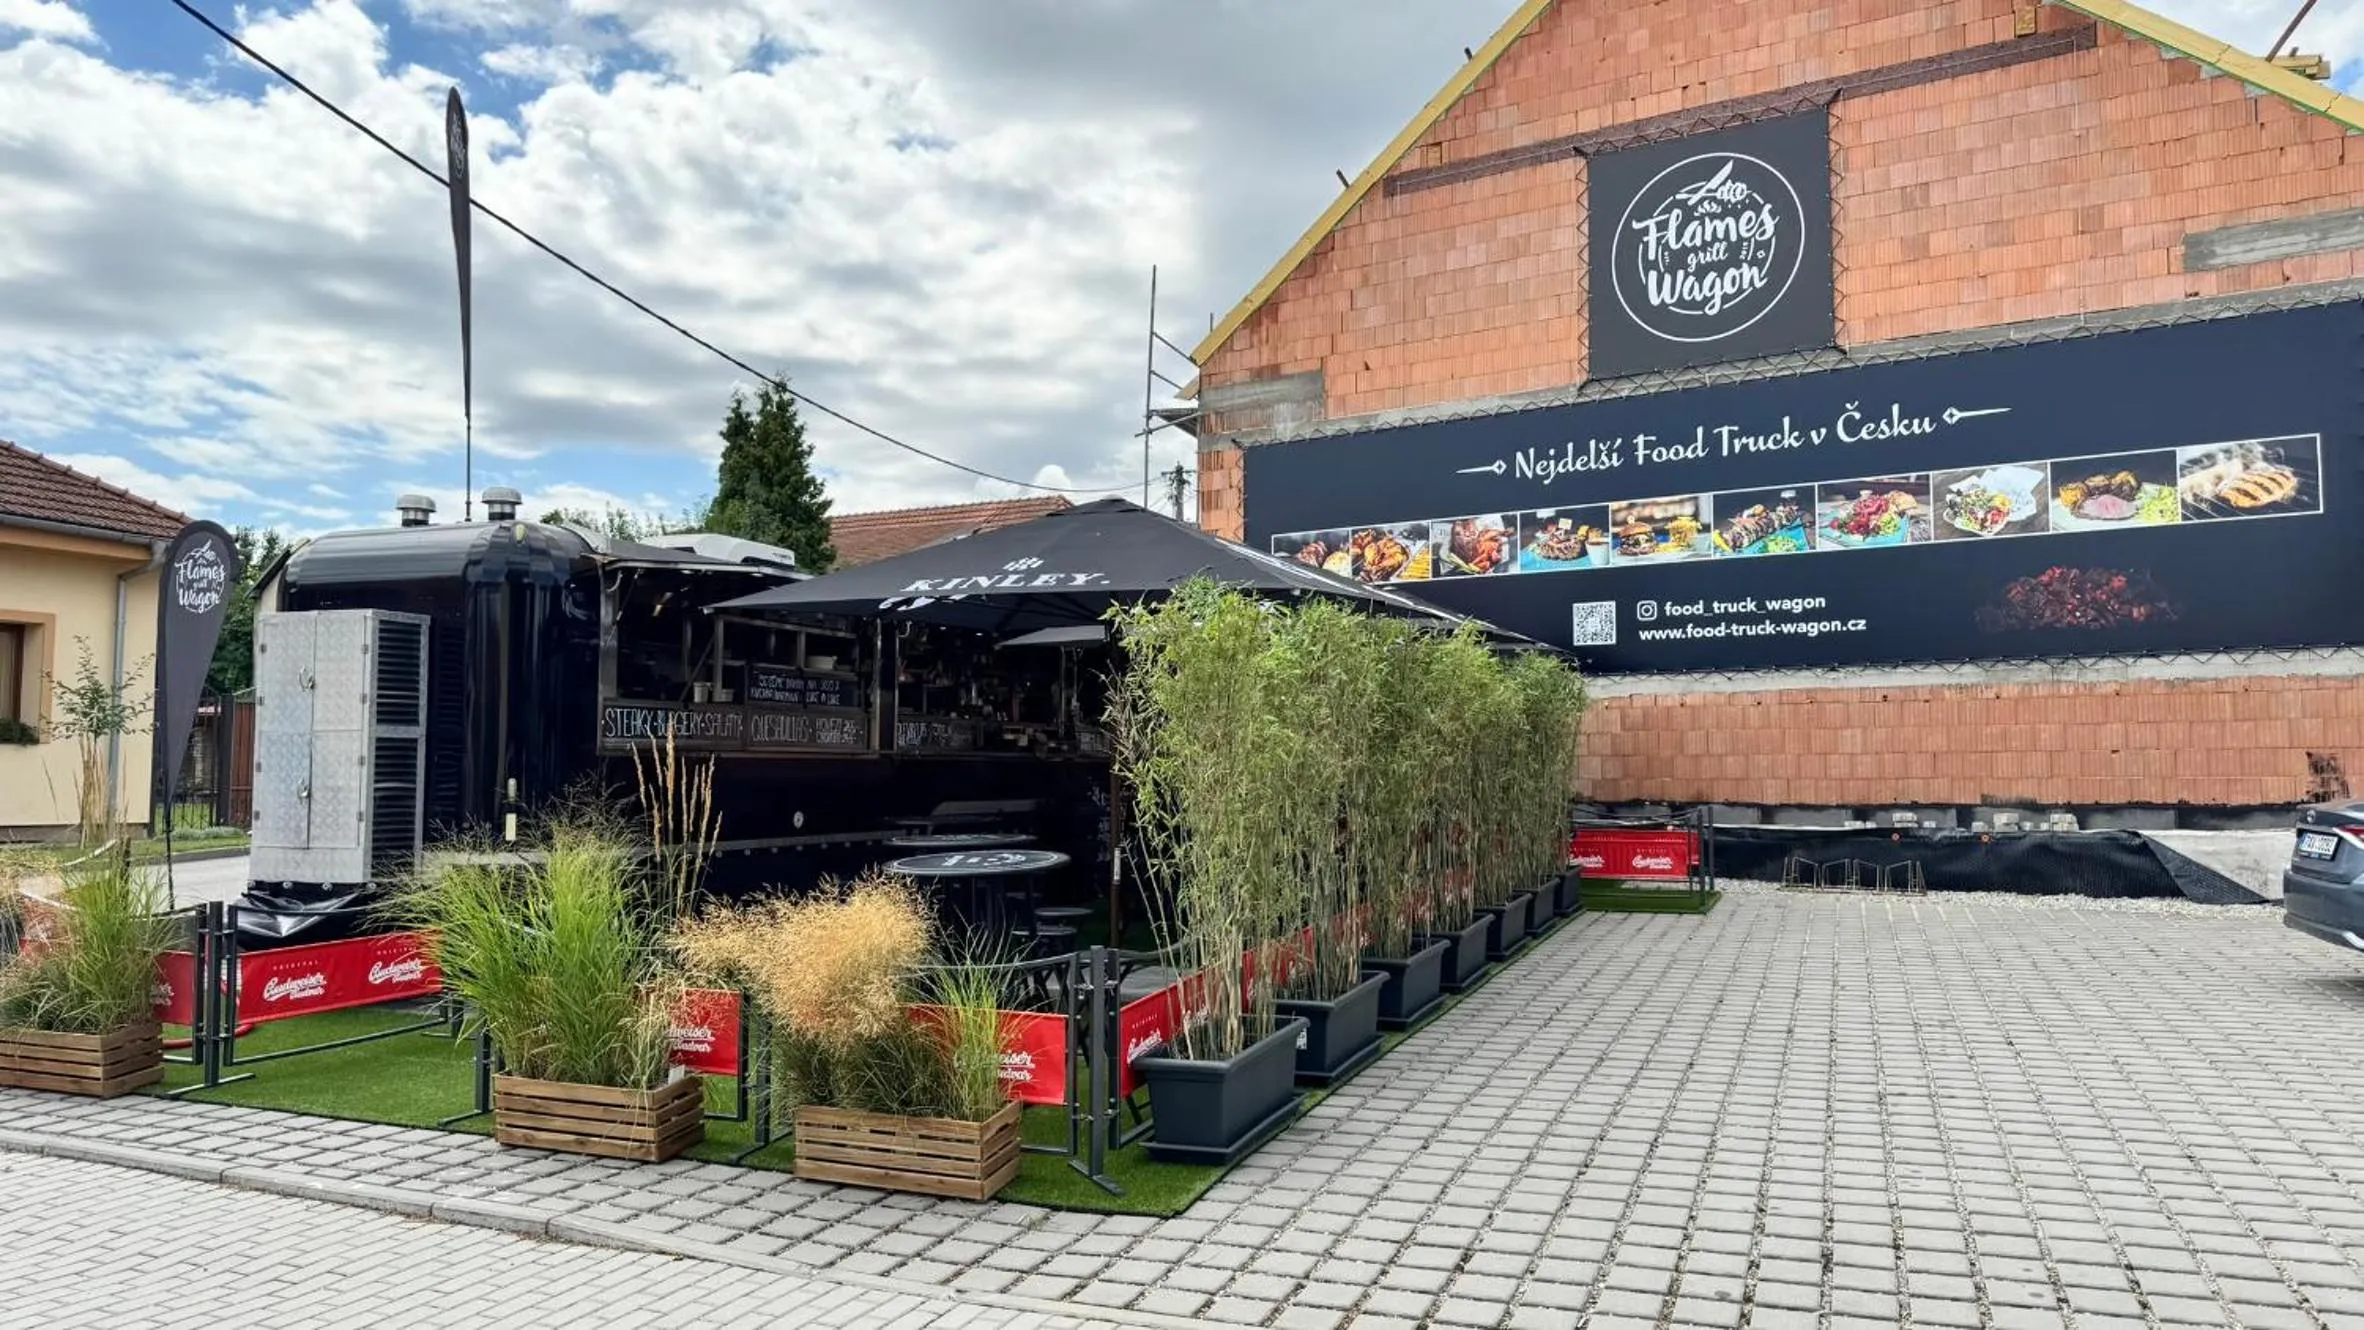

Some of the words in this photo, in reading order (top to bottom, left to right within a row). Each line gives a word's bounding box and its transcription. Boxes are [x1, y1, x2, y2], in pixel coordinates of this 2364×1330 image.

[1632, 203, 1780, 260] Flames
[1687, 241, 1728, 272] grill
[1648, 262, 1768, 315] Wagon
[1515, 438, 1624, 484] Nejdelší
[1633, 426, 1709, 465] Food
[1713, 416, 1805, 457] Truck
[1810, 427, 1827, 447] v
[1836, 400, 1937, 443] Česku
[174, 559, 226, 584] Flames
[180, 588, 220, 614] Wagon
[1664, 597, 1826, 617] food_truck_wagon
[1639, 618, 1867, 641] www.food-truck-wagon.cz
